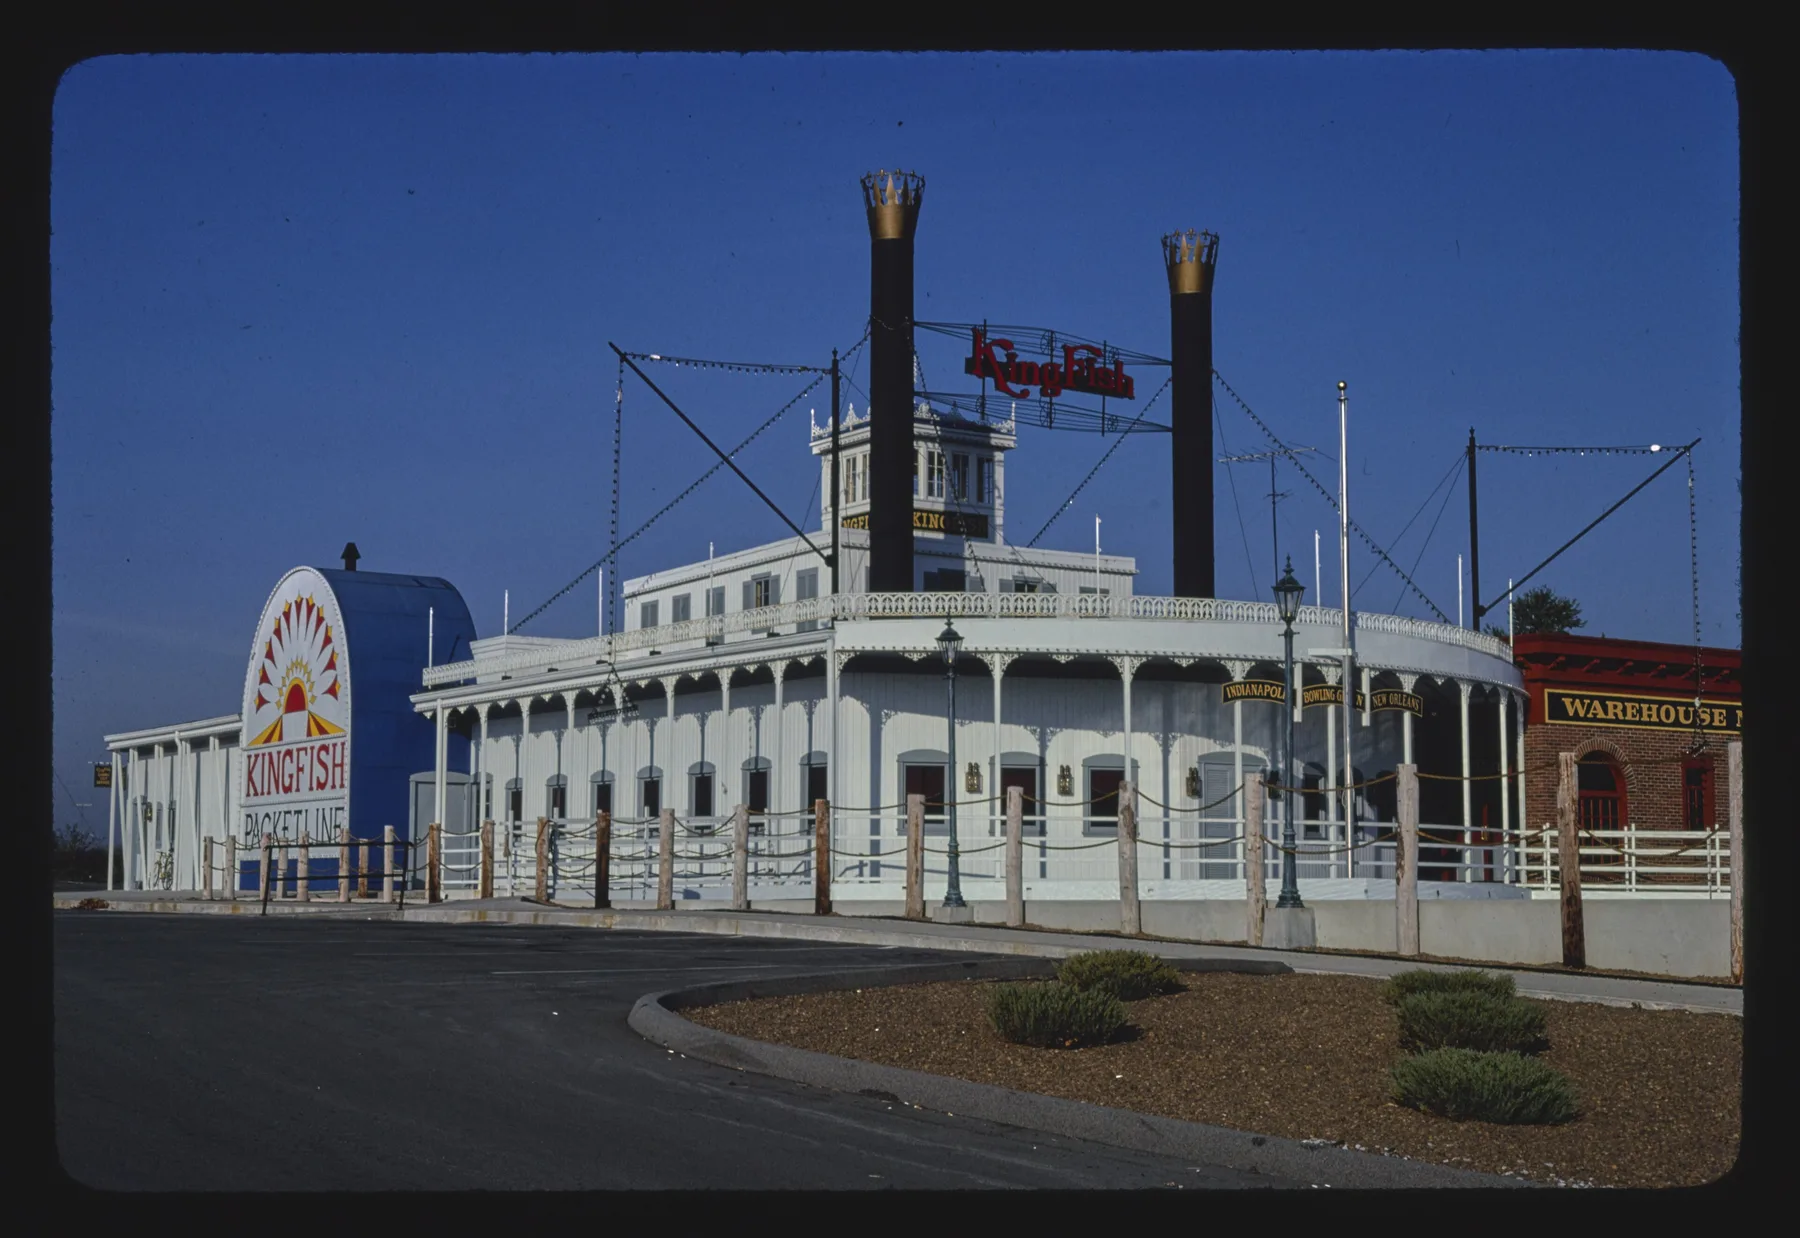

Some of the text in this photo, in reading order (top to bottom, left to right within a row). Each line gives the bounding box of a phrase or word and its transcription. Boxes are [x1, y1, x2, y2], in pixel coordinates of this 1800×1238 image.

[841, 514, 869, 530] NGFI
[1226, 683, 1285, 699] INDIANAPOL
[1303, 688, 1335, 703] BOWLING
[1372, 693, 1387, 708] NEW
[1389, 692, 1419, 711] ORLEANS
[1562, 697, 1727, 726] WAREHOUSE
[246, 741, 346, 797] KINGFISH
